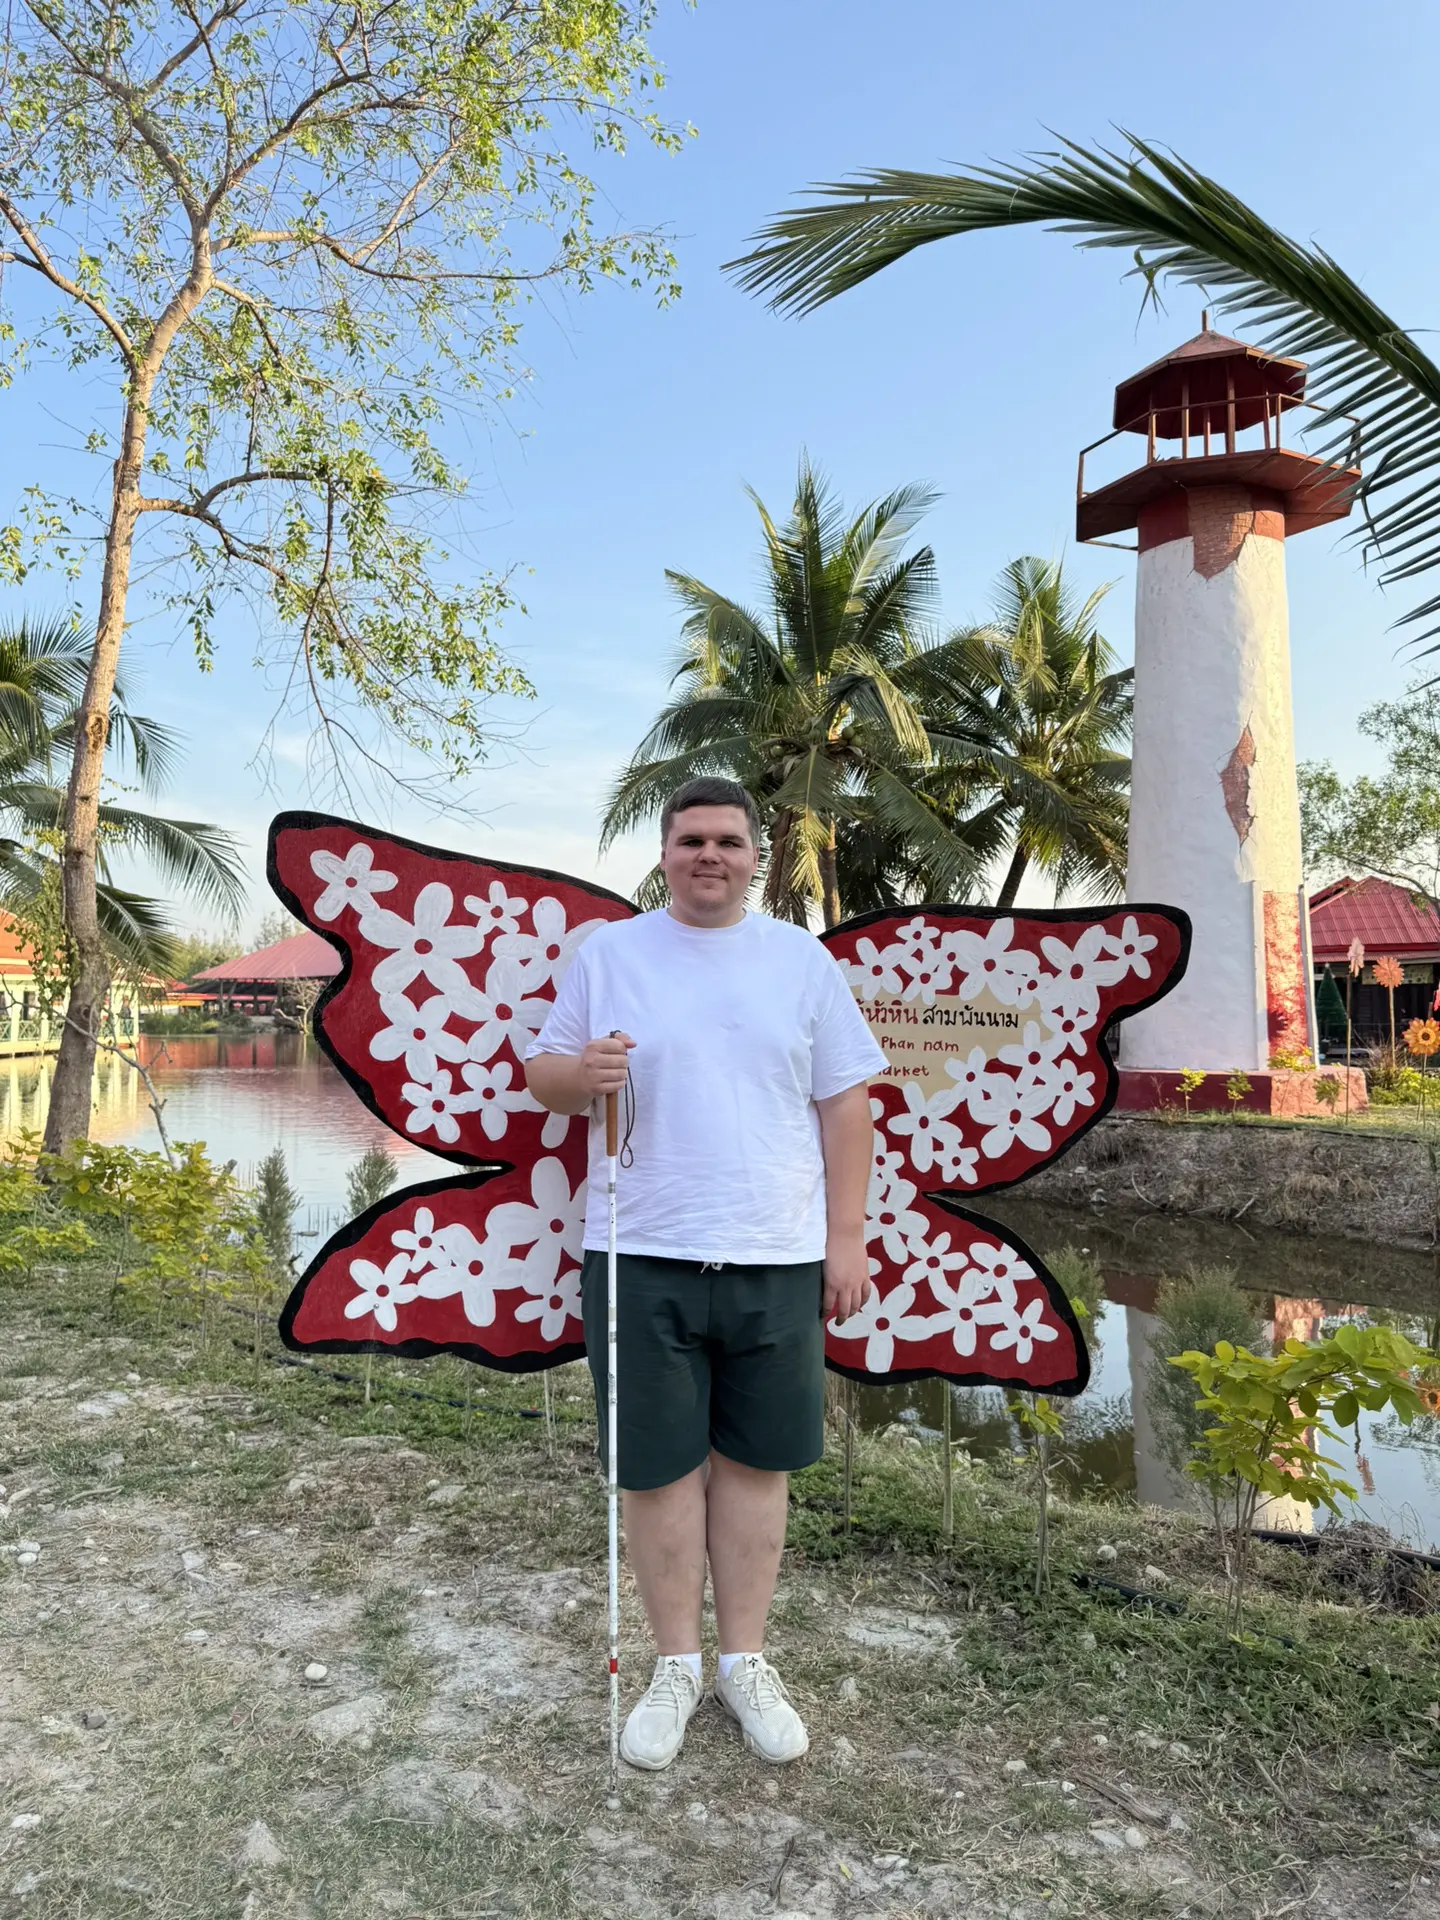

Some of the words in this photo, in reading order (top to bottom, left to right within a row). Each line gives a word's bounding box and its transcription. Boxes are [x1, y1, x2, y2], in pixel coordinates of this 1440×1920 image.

[922, 1004, 1019, 1028] สามพันนาม
[881, 1036, 915, 1050] Phan
[923, 1040, 960, 1052] nam
